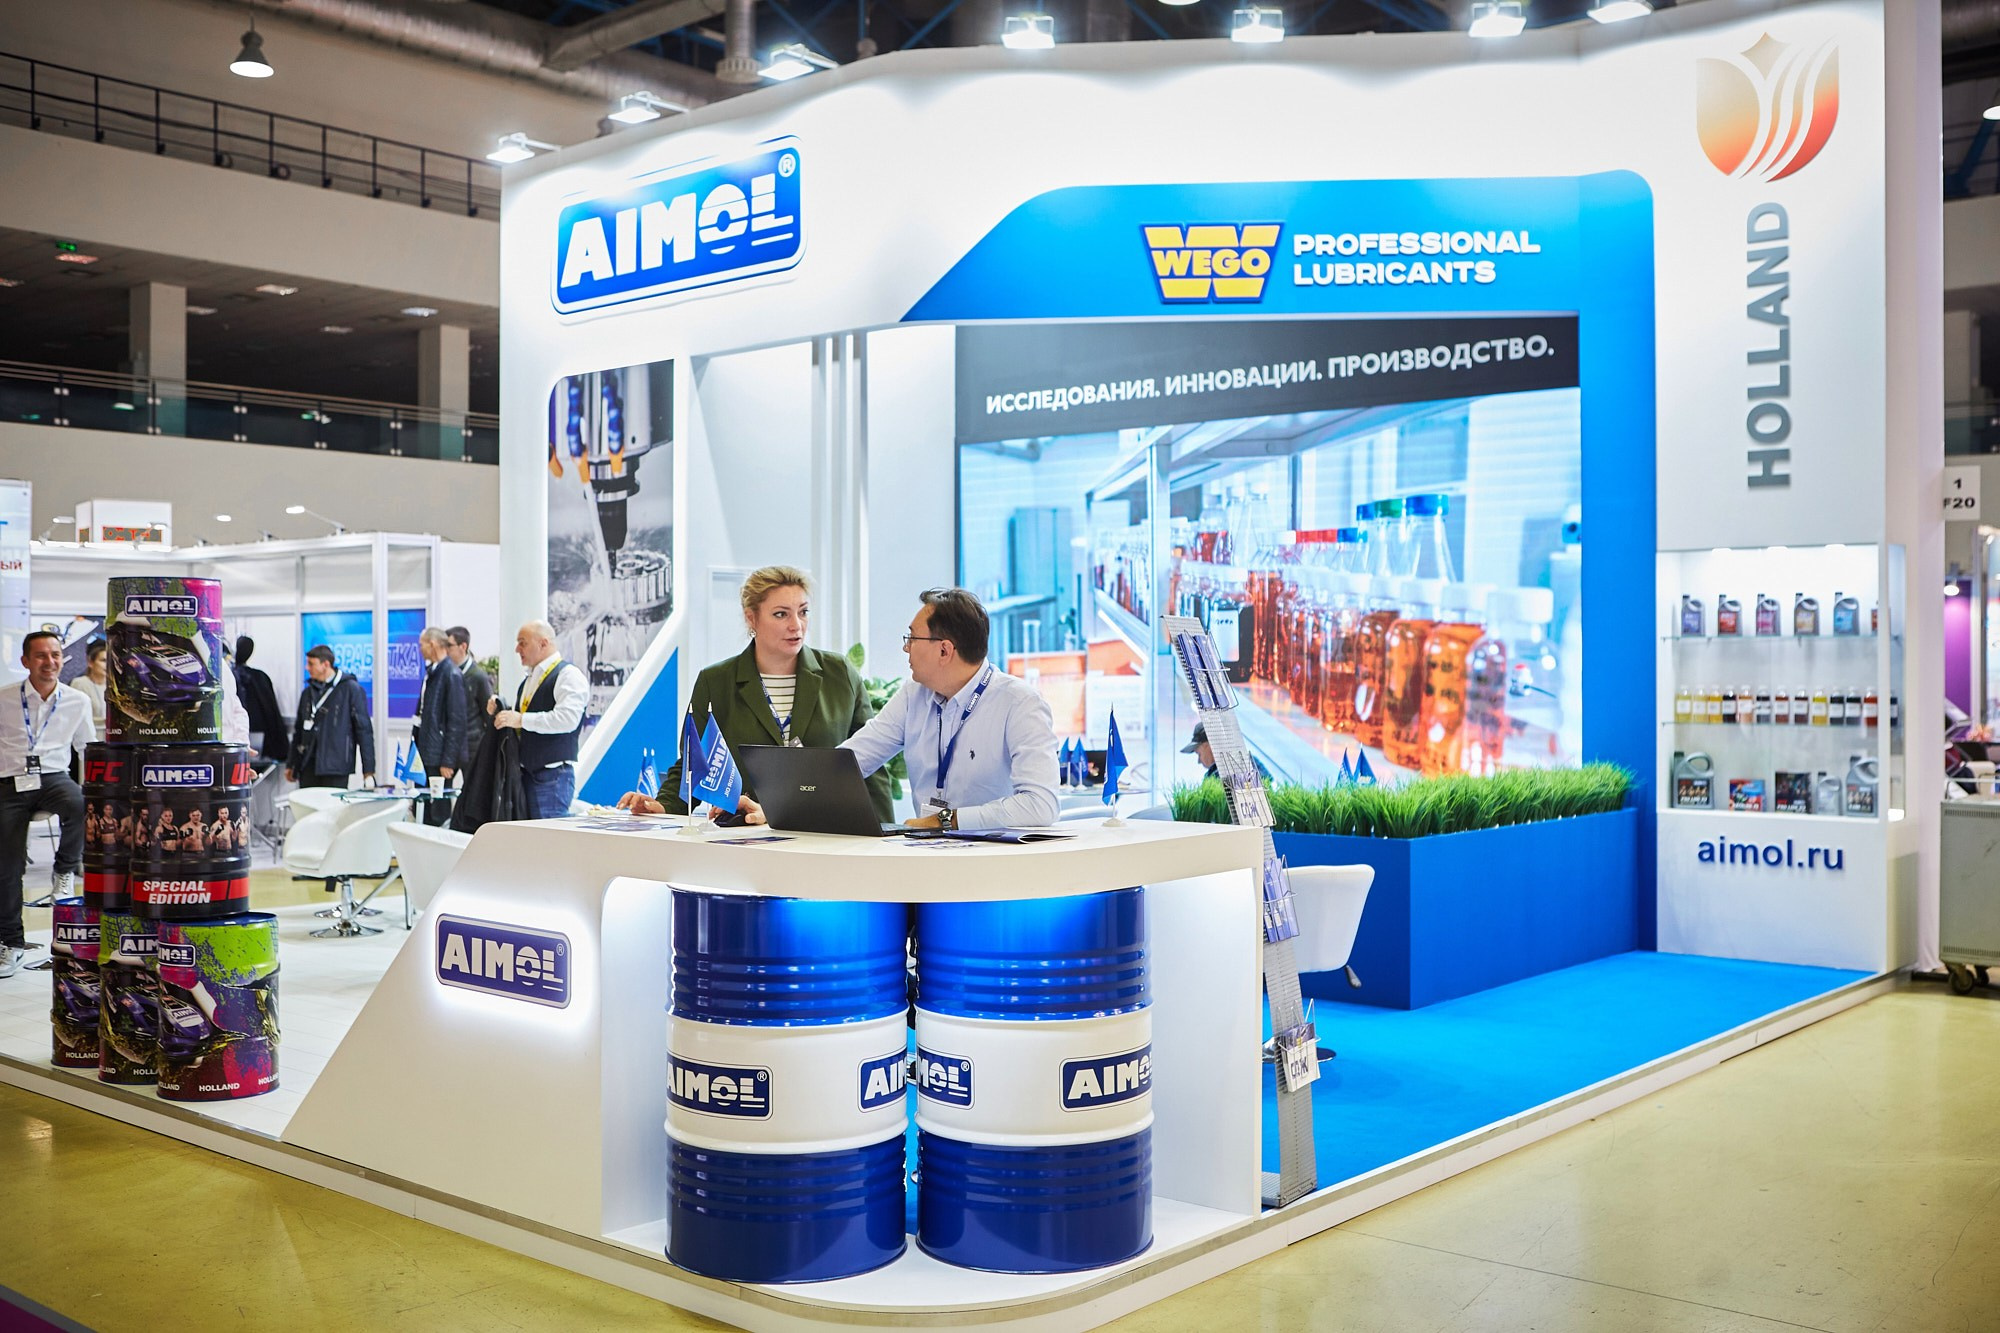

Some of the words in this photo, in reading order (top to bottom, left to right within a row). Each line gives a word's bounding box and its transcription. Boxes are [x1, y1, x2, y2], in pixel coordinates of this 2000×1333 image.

[1293, 230, 1541, 257] PROFESSIONAL
[1152, 249, 1271, 277] WEGO
[1293, 260, 1497, 286] LUBRICANTS
[1746, 201, 1792, 490] HOLLAND
[985, 377, 1161, 415] ИССЛЕДОВАНИЯ.
[1164, 359, 1323, 397] ИННОВАЦИИ.
[1327, 334, 1555, 380] ПРОИЗВОДСТВО.
[1953, 478, 1962, 489] 1
[127, 600, 195, 613] AIMOL
[1698, 836, 1844, 870] aimol.ru
[142, 880, 206, 892] SPECIAL
[148, 892, 212, 905] EDITION
[199, 1082, 241, 1092] HOLLAND
